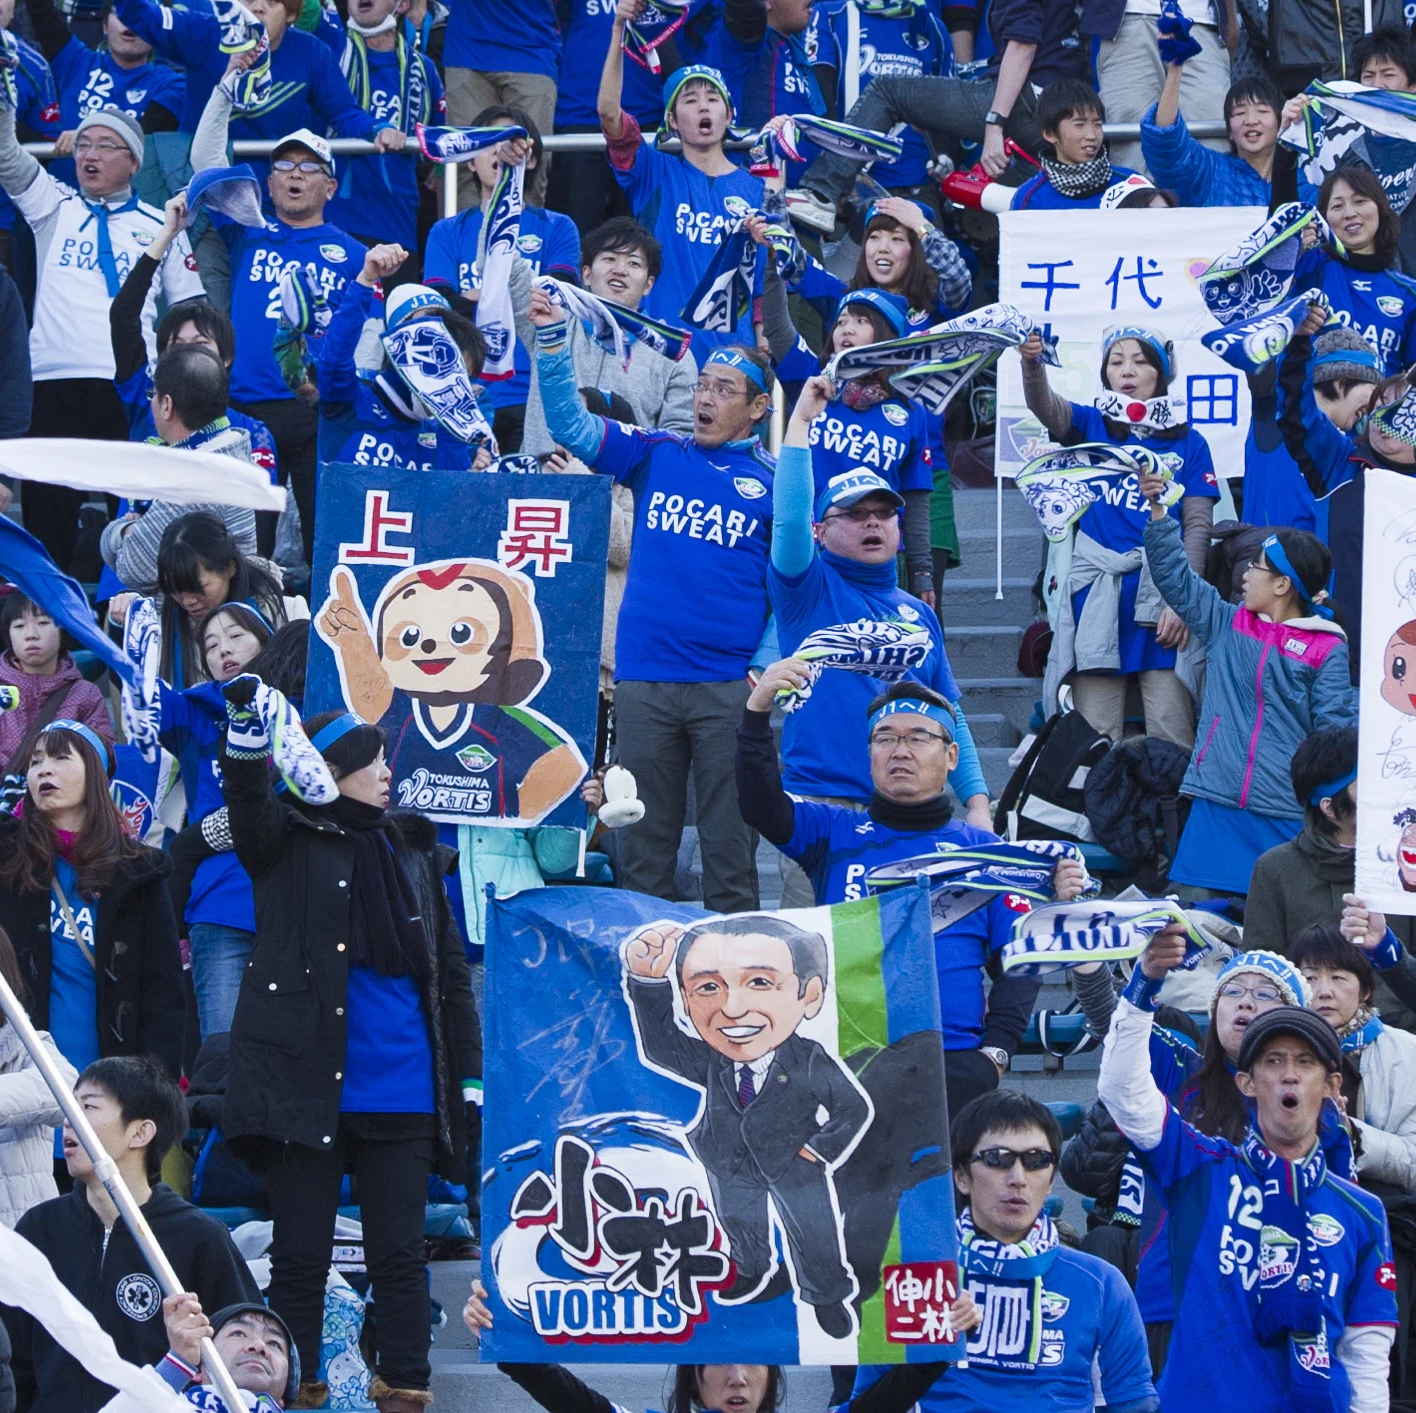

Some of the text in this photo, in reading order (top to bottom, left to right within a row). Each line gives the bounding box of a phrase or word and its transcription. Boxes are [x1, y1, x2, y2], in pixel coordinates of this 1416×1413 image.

[1020, 256, 1164, 312] 千代
[1186, 374, 1239, 427] 田
[806, 425, 898, 472] SWEAT
[808, 409, 907, 456] POCARI
[645, 510, 745, 550] SWEAT
[648, 489, 758, 538] POCARI
[878, 697, 934, 718] J1へ!!
[397, 767, 493, 815] VORTIS
[428, 771, 493, 789] TOKUSHIMA
[511, 1134, 731, 1315] 小林
[1227, 1176, 1264, 1231] 12
[530, 1282, 689, 1338] VORTIS
